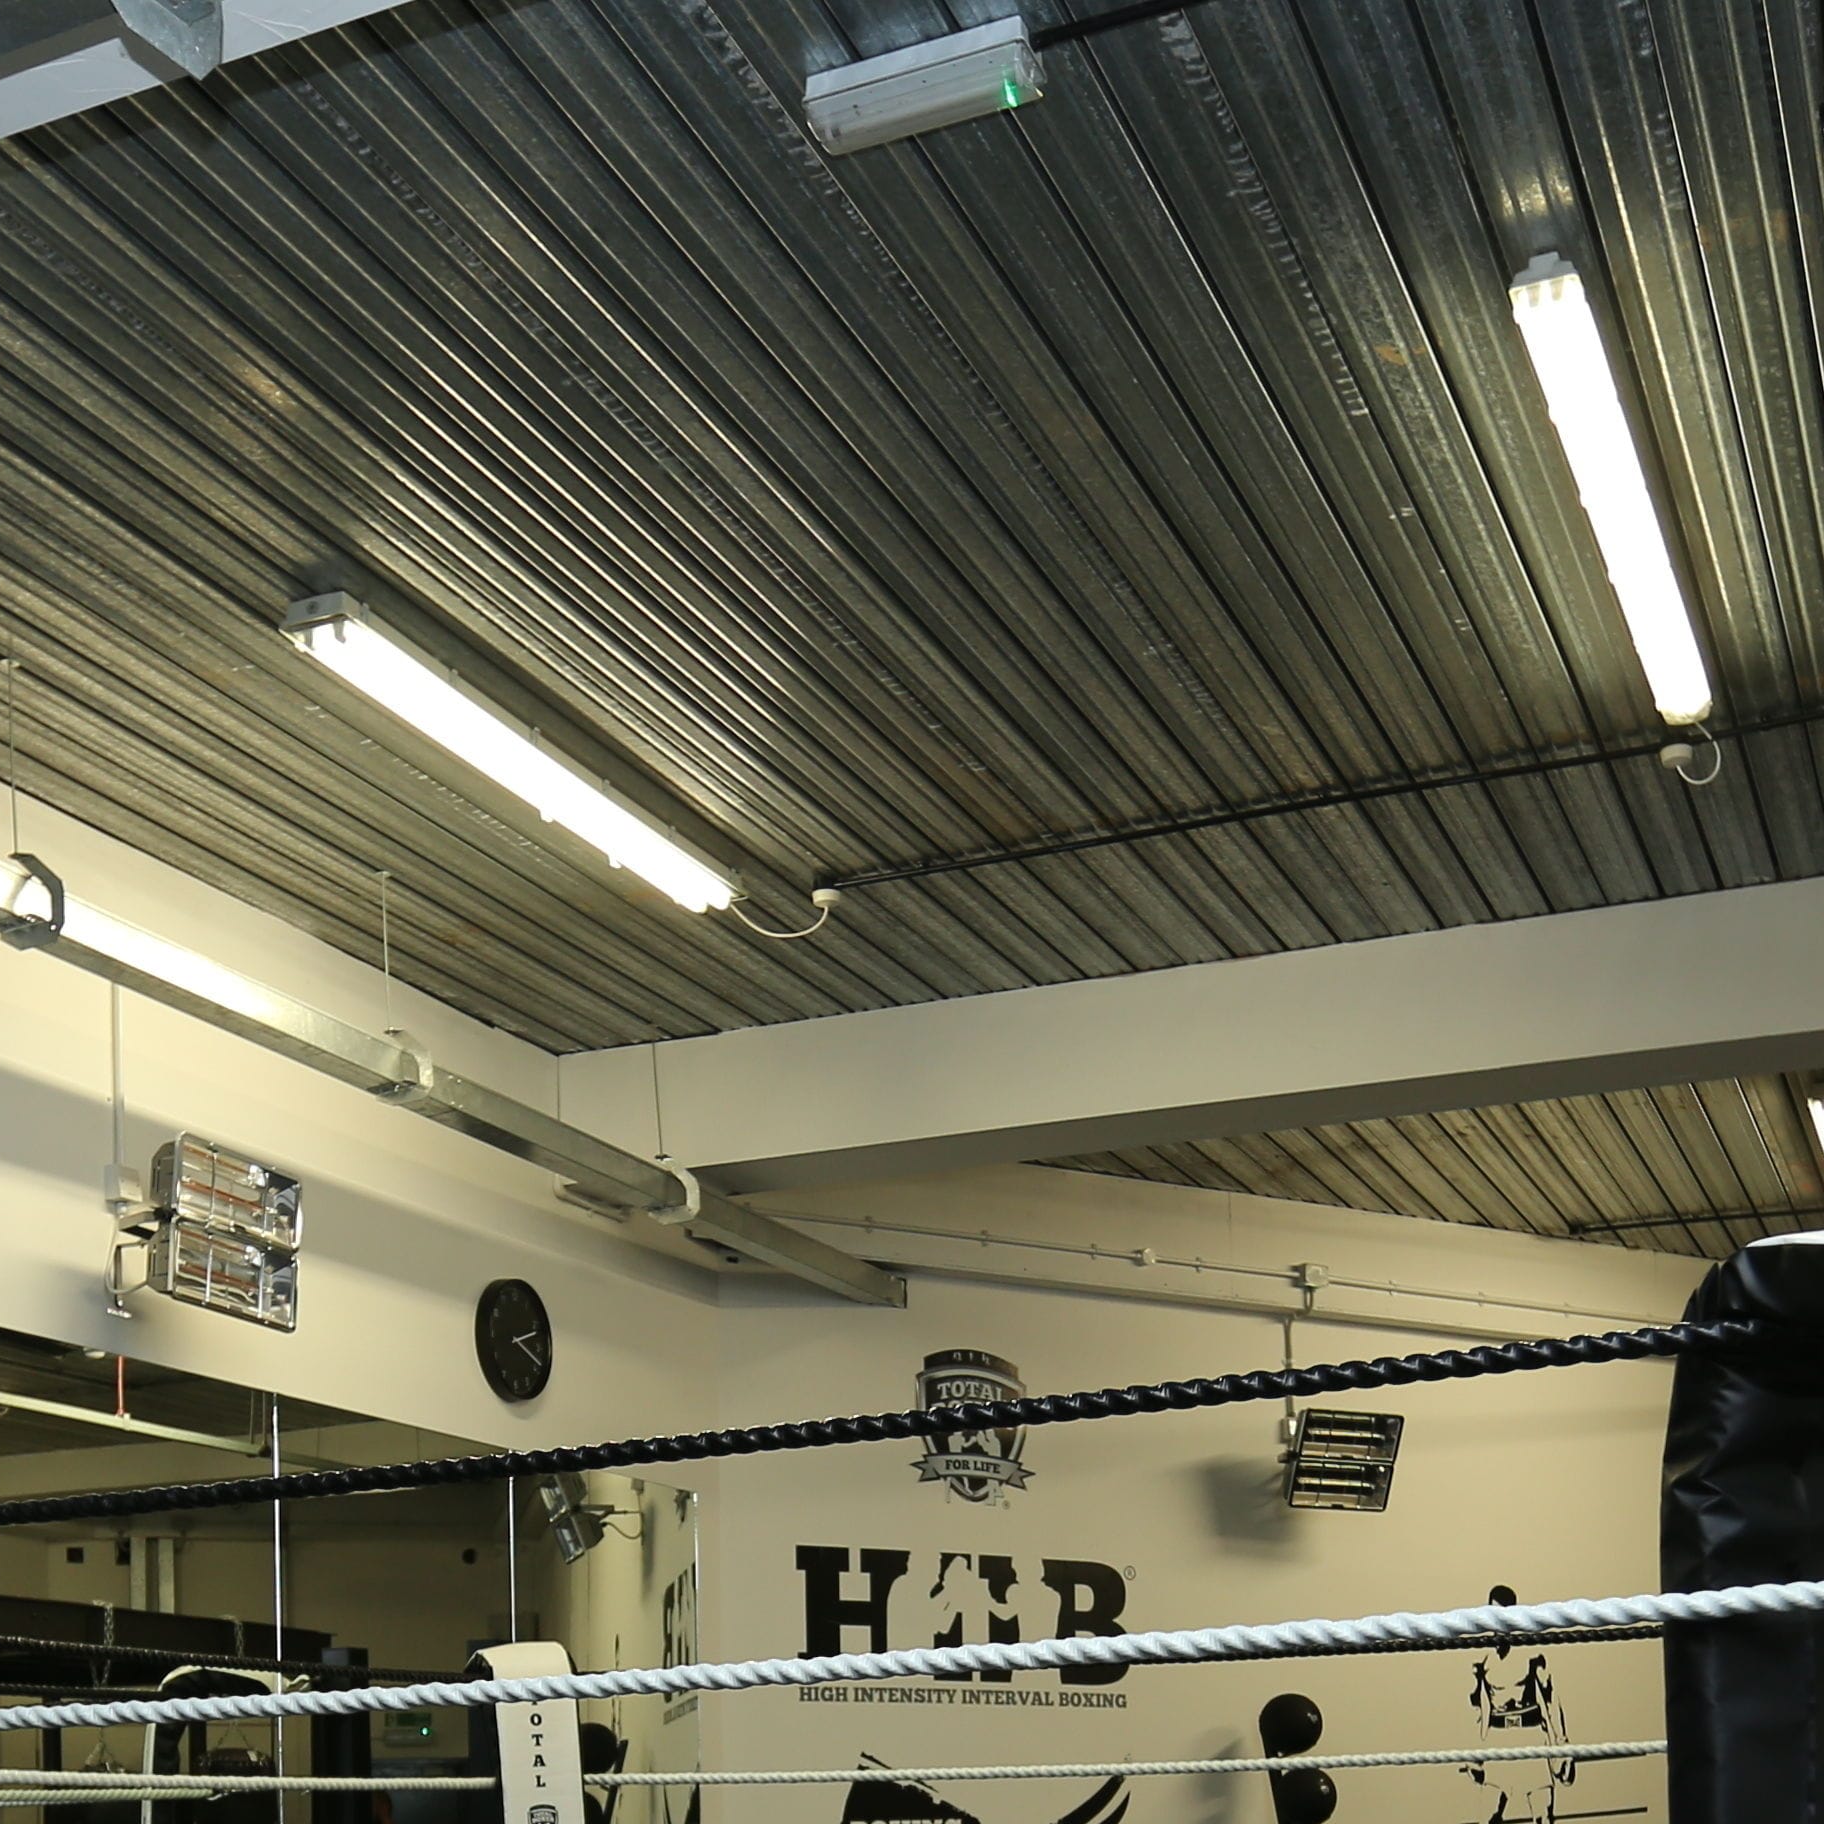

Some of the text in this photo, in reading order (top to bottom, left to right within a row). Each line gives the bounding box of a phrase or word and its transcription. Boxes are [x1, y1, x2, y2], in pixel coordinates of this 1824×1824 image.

[945, 1459, 1001, 1474] FOR LIFE
[799, 1686, 1128, 1708] HIGH INTENSITY INTERVAL BOXING
[529, 1701, 547, 1788] OTAL
